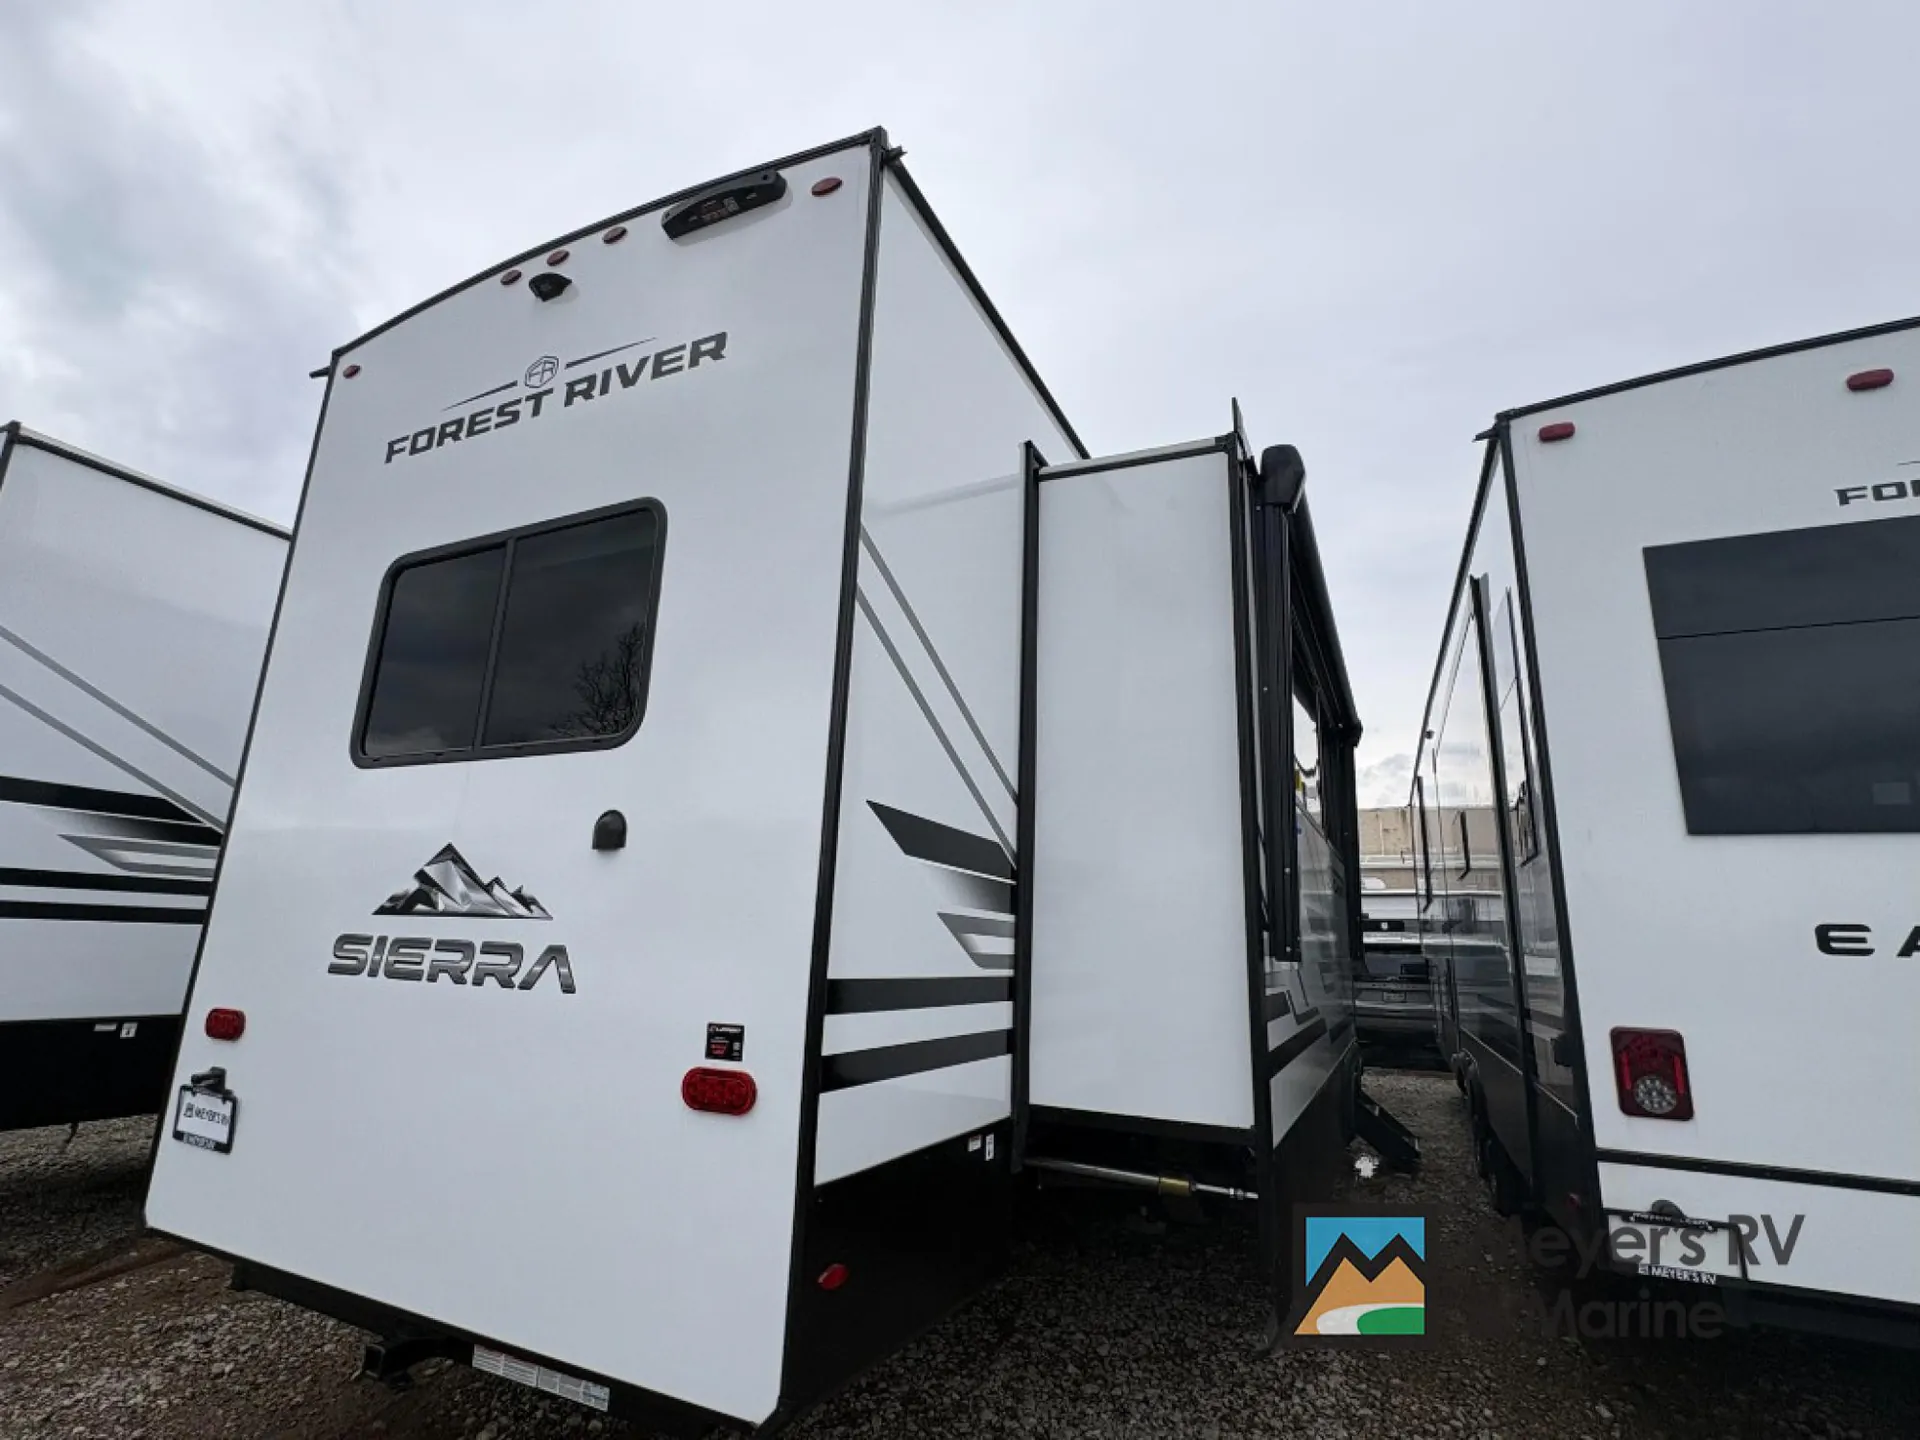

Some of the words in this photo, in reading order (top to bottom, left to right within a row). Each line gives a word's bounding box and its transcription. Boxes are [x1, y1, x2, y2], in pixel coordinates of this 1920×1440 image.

[384, 388, 553, 464] FOREST
[563, 332, 728, 407] RIVER
[1834, 480, 1920, 506] FO
[328, 933, 576, 994] SIERRA
